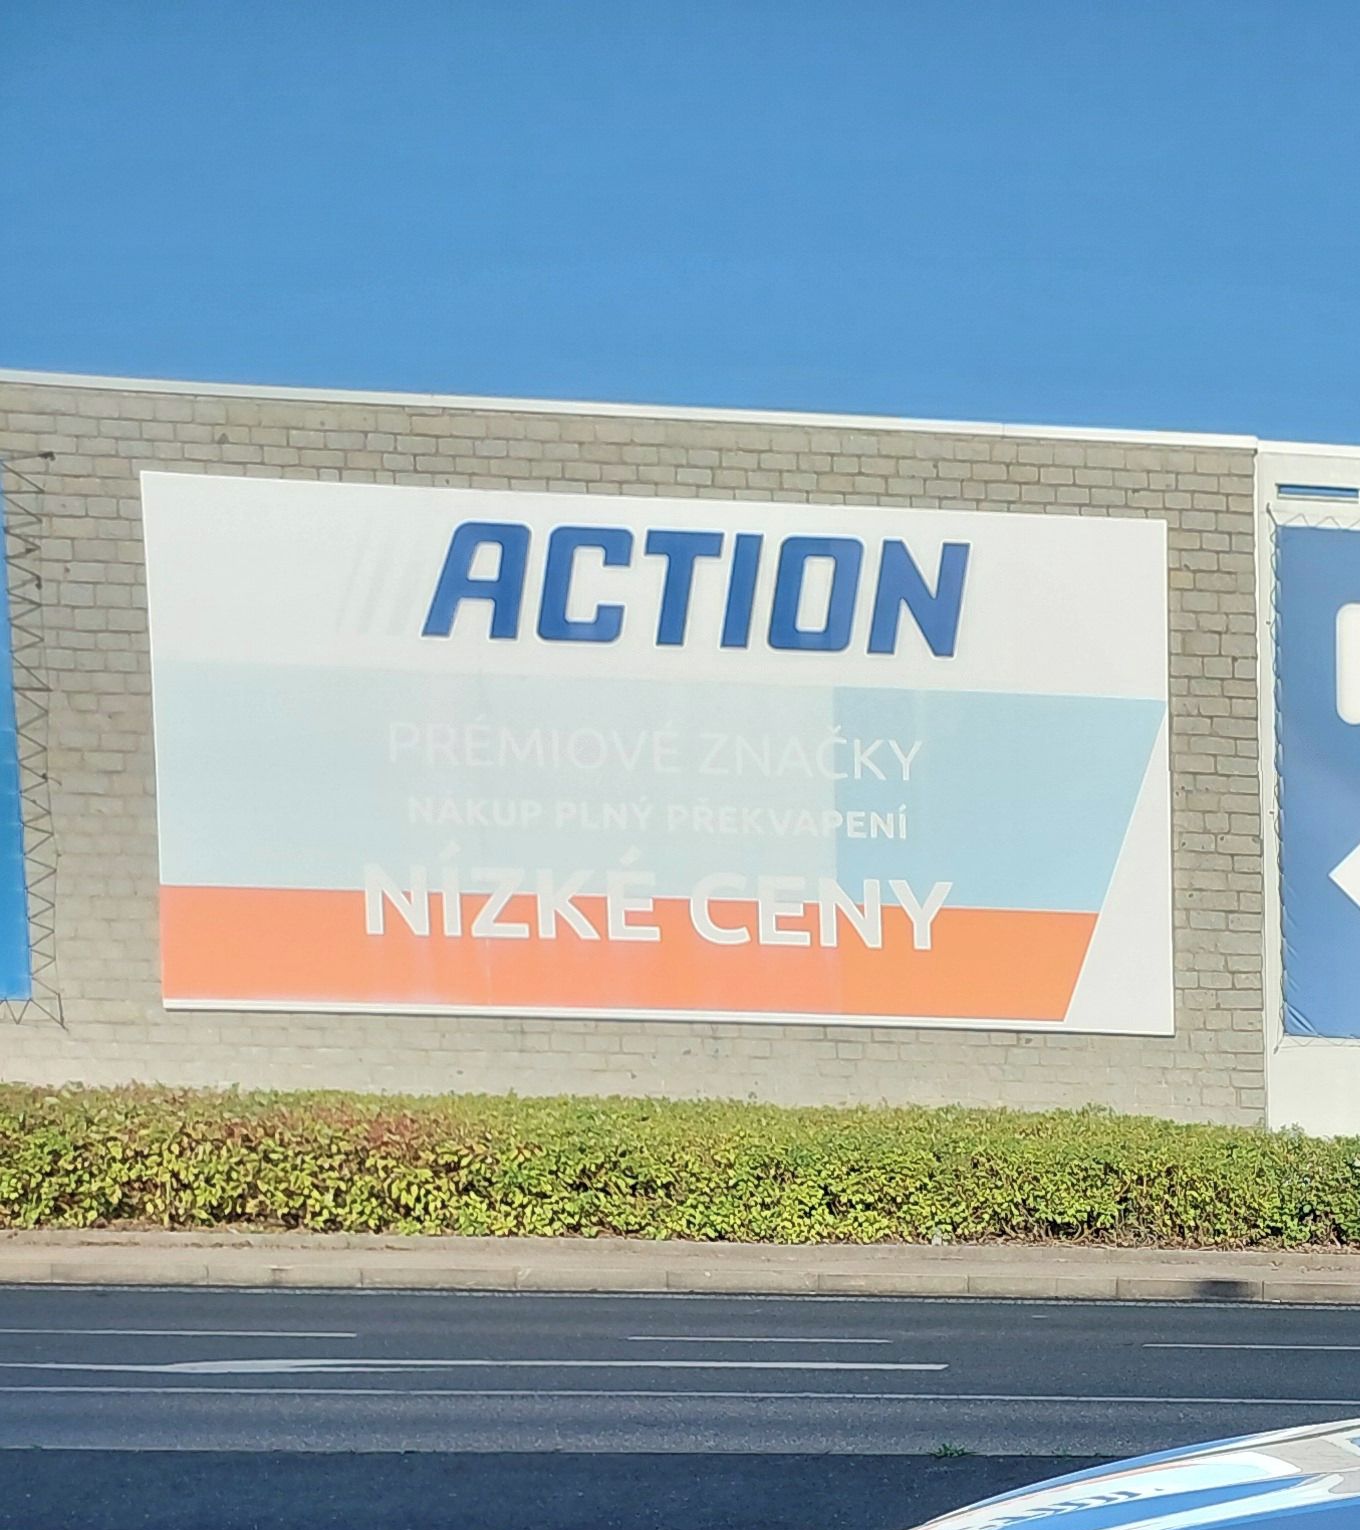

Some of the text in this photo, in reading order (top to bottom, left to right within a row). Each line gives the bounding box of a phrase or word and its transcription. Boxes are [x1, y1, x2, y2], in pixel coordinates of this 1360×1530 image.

[420, 520, 971, 659] ACTION
[387, 714, 923, 782] PRÉMIOVÉ ZNAČKY
[555, 795, 655, 831] PLNÝ
[667, 798, 909, 840] PŘEKVAPENÍ
[364, 841, 954, 951] NÍZKÉ CENY
